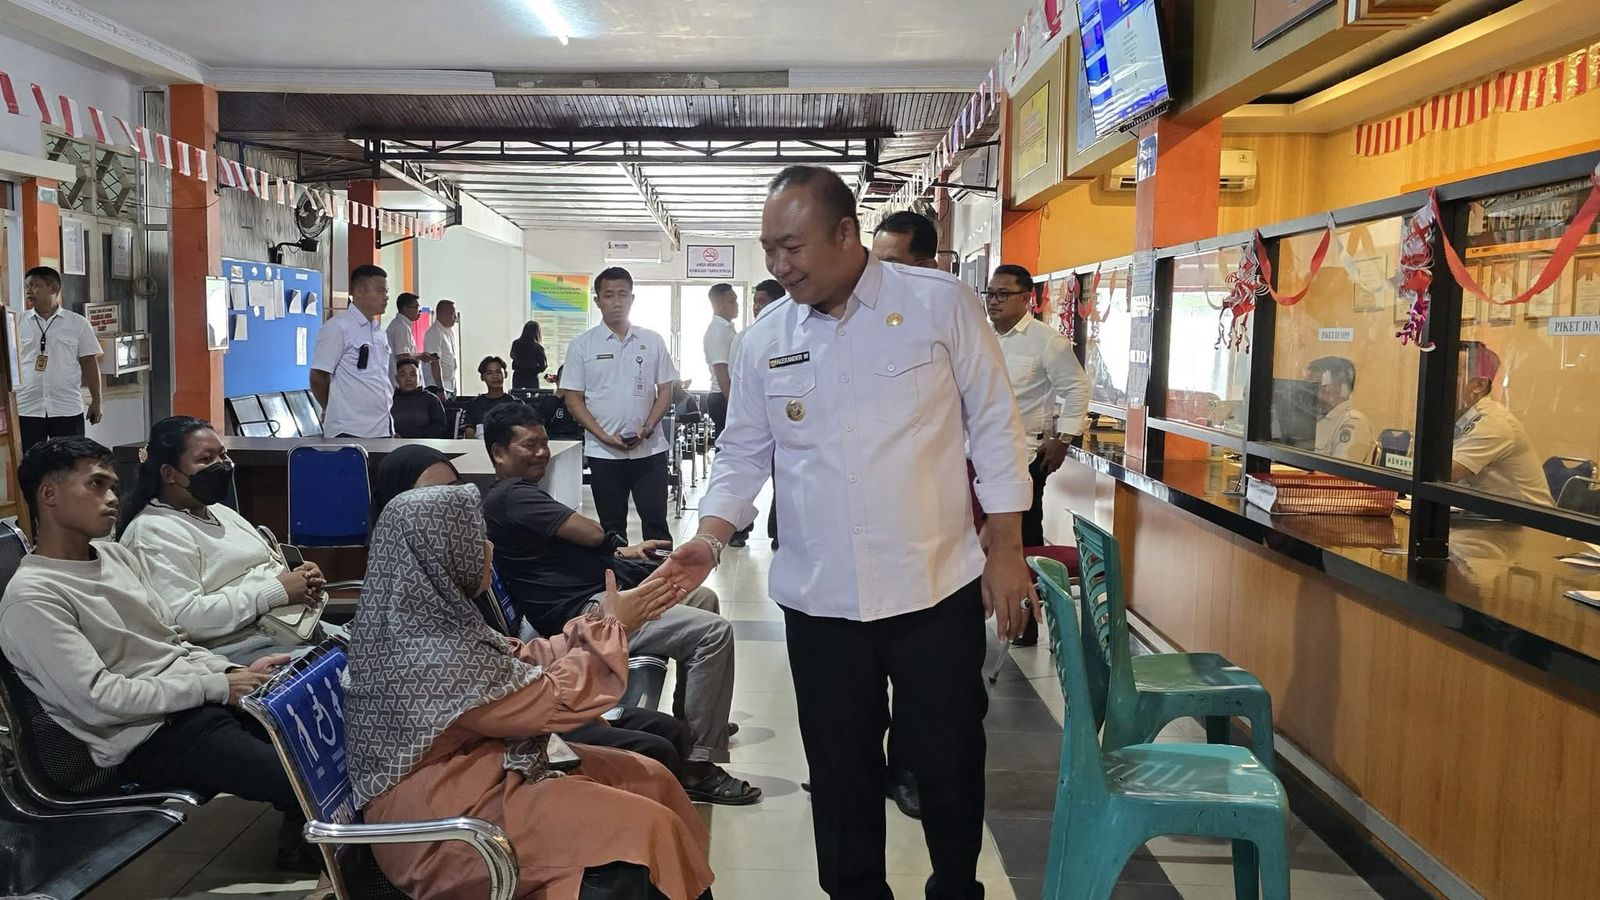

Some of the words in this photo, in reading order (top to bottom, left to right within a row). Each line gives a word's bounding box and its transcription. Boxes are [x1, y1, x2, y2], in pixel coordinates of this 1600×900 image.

[1499, 201, 1570, 230] KETAPANG
[1555, 321, 1580, 332] PIKET
[1582, 320, 1592, 331] DI
[1321, 331, 1334, 339] PIKET
[776, 354, 803, 365] ALEXANDER
